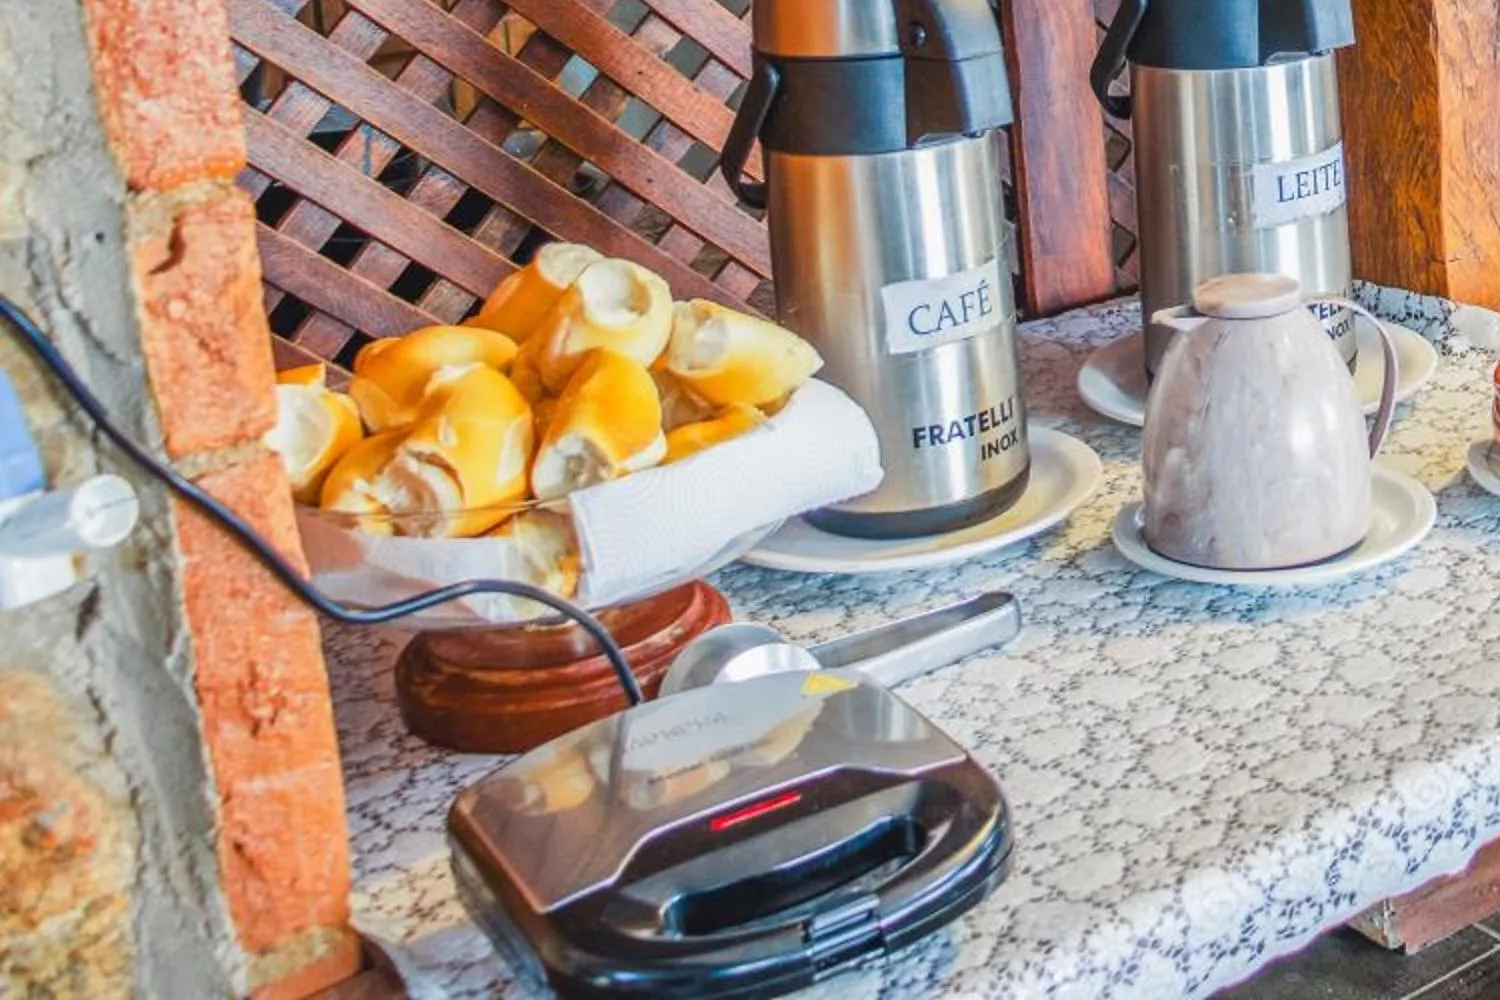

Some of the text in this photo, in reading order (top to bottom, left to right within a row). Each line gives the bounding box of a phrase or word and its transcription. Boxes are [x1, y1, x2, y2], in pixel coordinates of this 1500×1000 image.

[1277, 157, 1341, 203] LEITE
[908, 279, 993, 335] CAFÉ
[912, 396, 1014, 449] FRATELLI
[981, 427, 1019, 461] INOX
